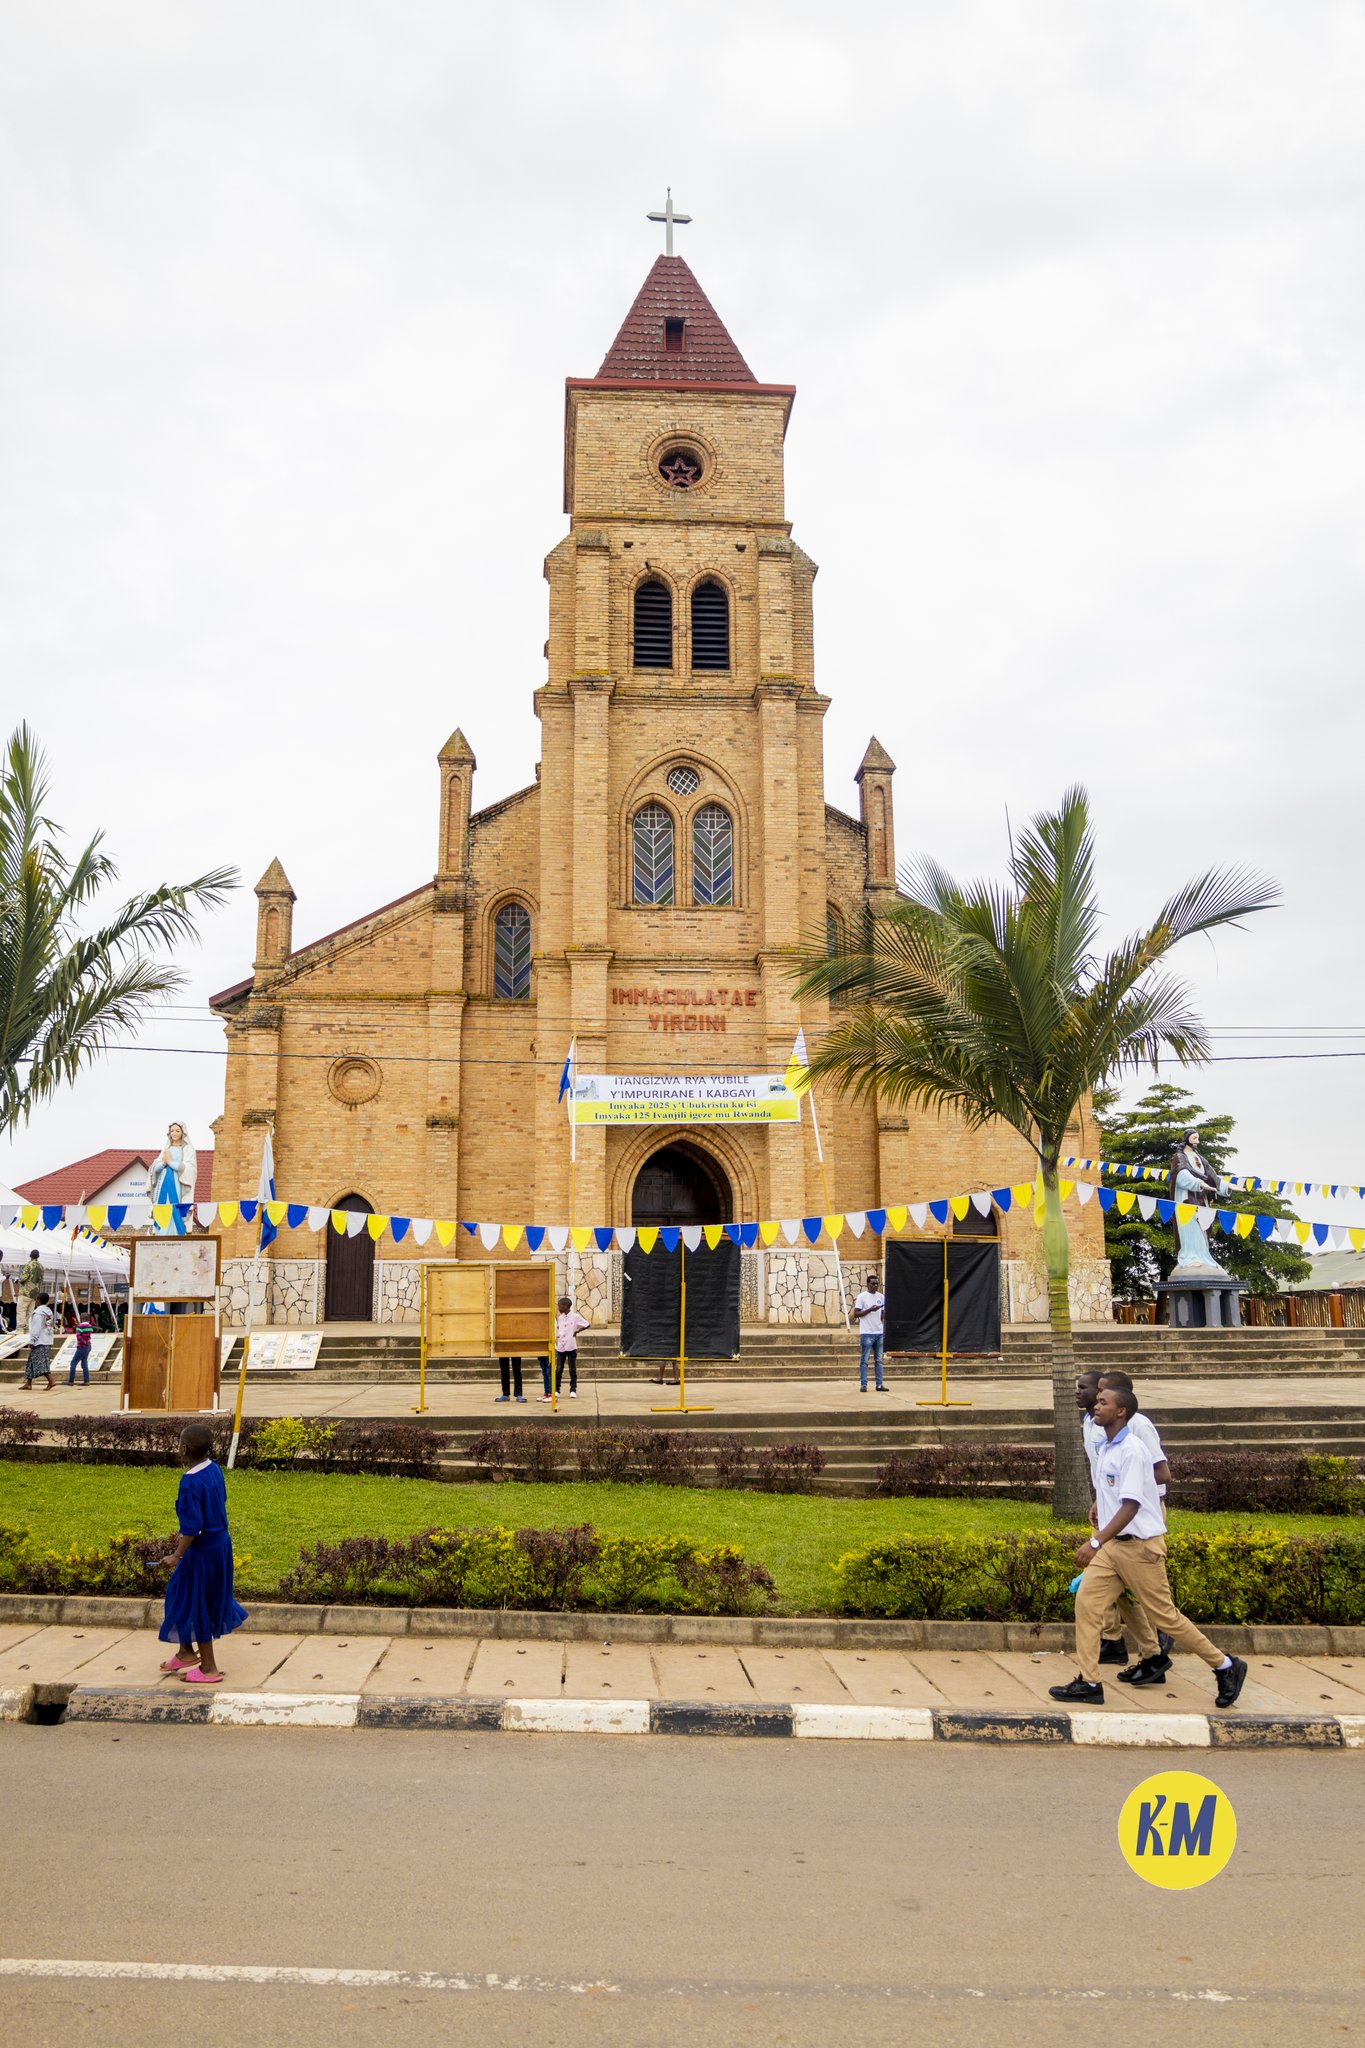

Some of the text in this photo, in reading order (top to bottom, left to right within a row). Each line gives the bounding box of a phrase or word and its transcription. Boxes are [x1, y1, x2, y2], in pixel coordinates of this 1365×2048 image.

[612, 988, 757, 1006] IMMACULATAE
[649, 1014, 726, 1031] VIRGINI
[615, 1076, 750, 1085] ITANGIZWA RYA YUBILE
[610, 1090, 755, 1099] Y'IMPURIRANE I KABGAYI
[609, 1103, 645, 1112] Imyaka
[595, 1113, 630, 1121] Imyaka
[653, 1112, 687, 1120] Ivanjili
[689, 1112, 713, 1120] igeze
